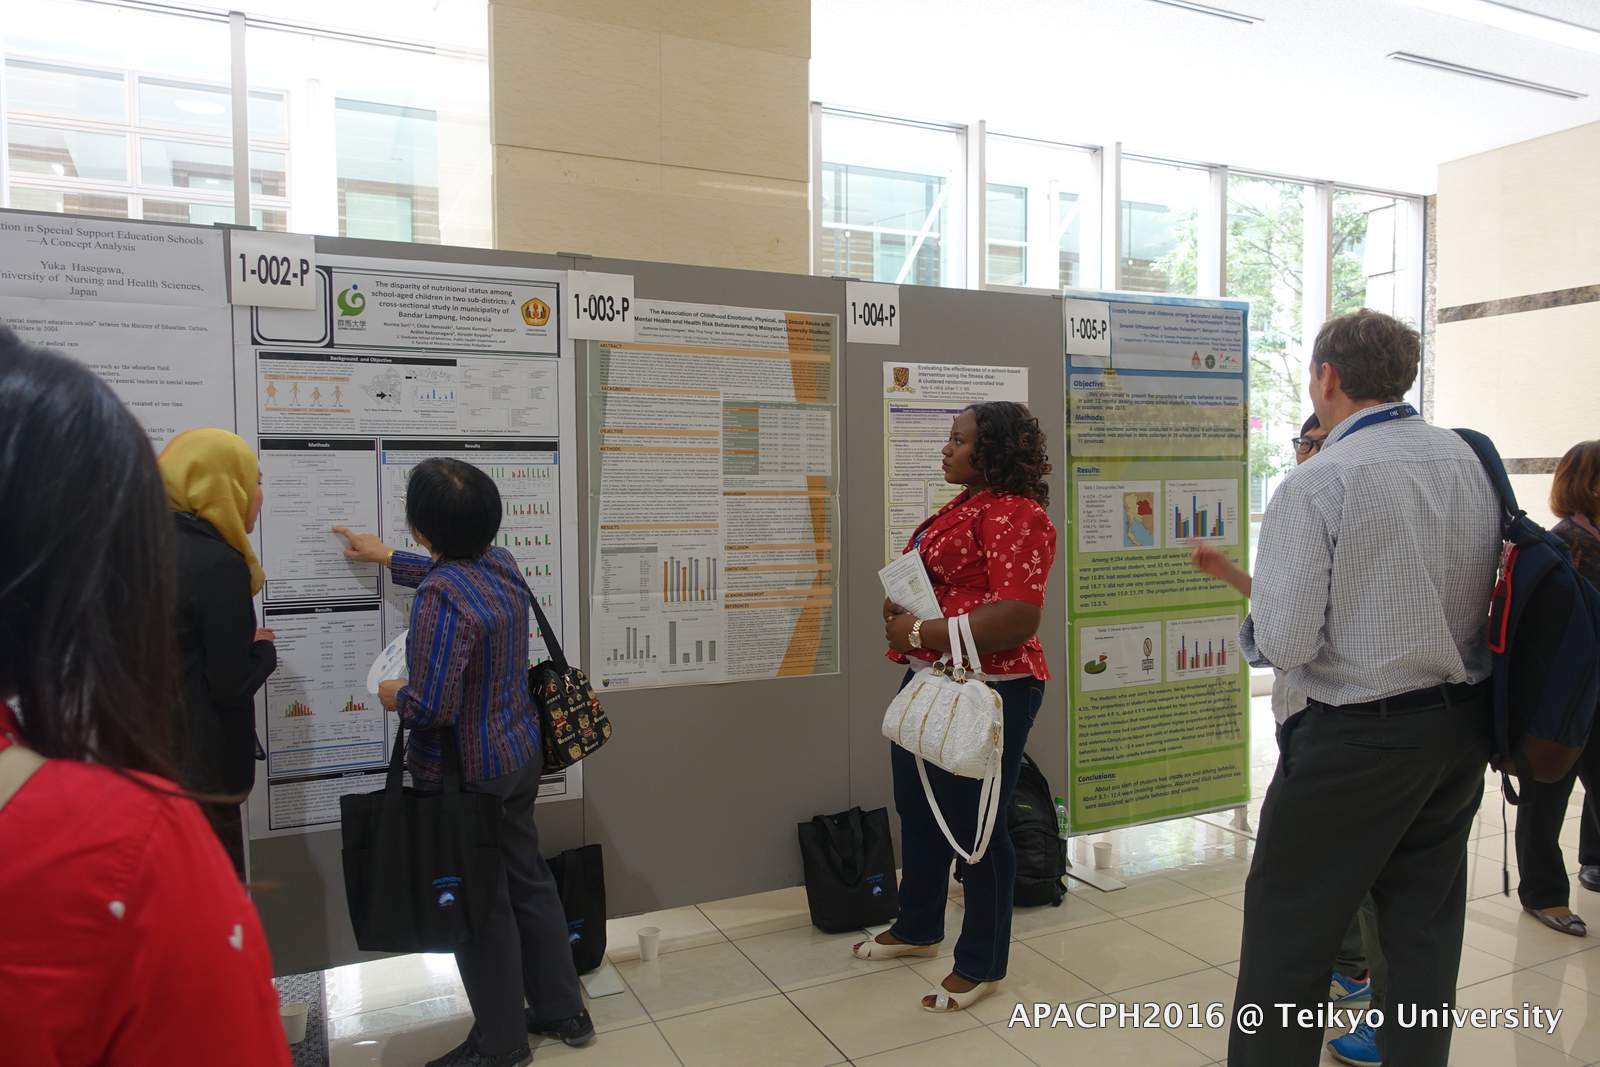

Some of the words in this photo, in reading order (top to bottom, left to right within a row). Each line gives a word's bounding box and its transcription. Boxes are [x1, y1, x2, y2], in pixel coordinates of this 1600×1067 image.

[37, 224, 73, 236] Special
[76, 227, 114, 239] Support
[117, 231, 165, 242] Education
[168, 234, 204, 245] Schools
[51, 238, 92, 250] Concept
[94, 241, 136, 252] Analysis
[40, 260, 66, 271] Yuka
[72, 263, 124, 275] Hasegawa,
[240, 253, 310, 286] 1-002-P
[48, 274, 60, 282] of
[65, 274, 104, 286] Nursing
[106, 277, 124, 286] and
[127, 278, 158, 288] Health
[161, 281, 204, 292] Sciences,
[390, 282, 420, 290] disparity
[490, 290, 512, 298] among
[70, 286, 98, 297] Japan
[371, 290, 414, 300] school-aged
[415, 293, 443, 301] children
[432, 304, 451, 312] study
[460, 306, 501, 314] municipality
[574, 293, 630, 322] 1-003-P
[852, 302, 896, 326] 1-004-P
[424, 314, 458, 322] Lampung,
[1070, 317, 1107, 341] 1-005-P
